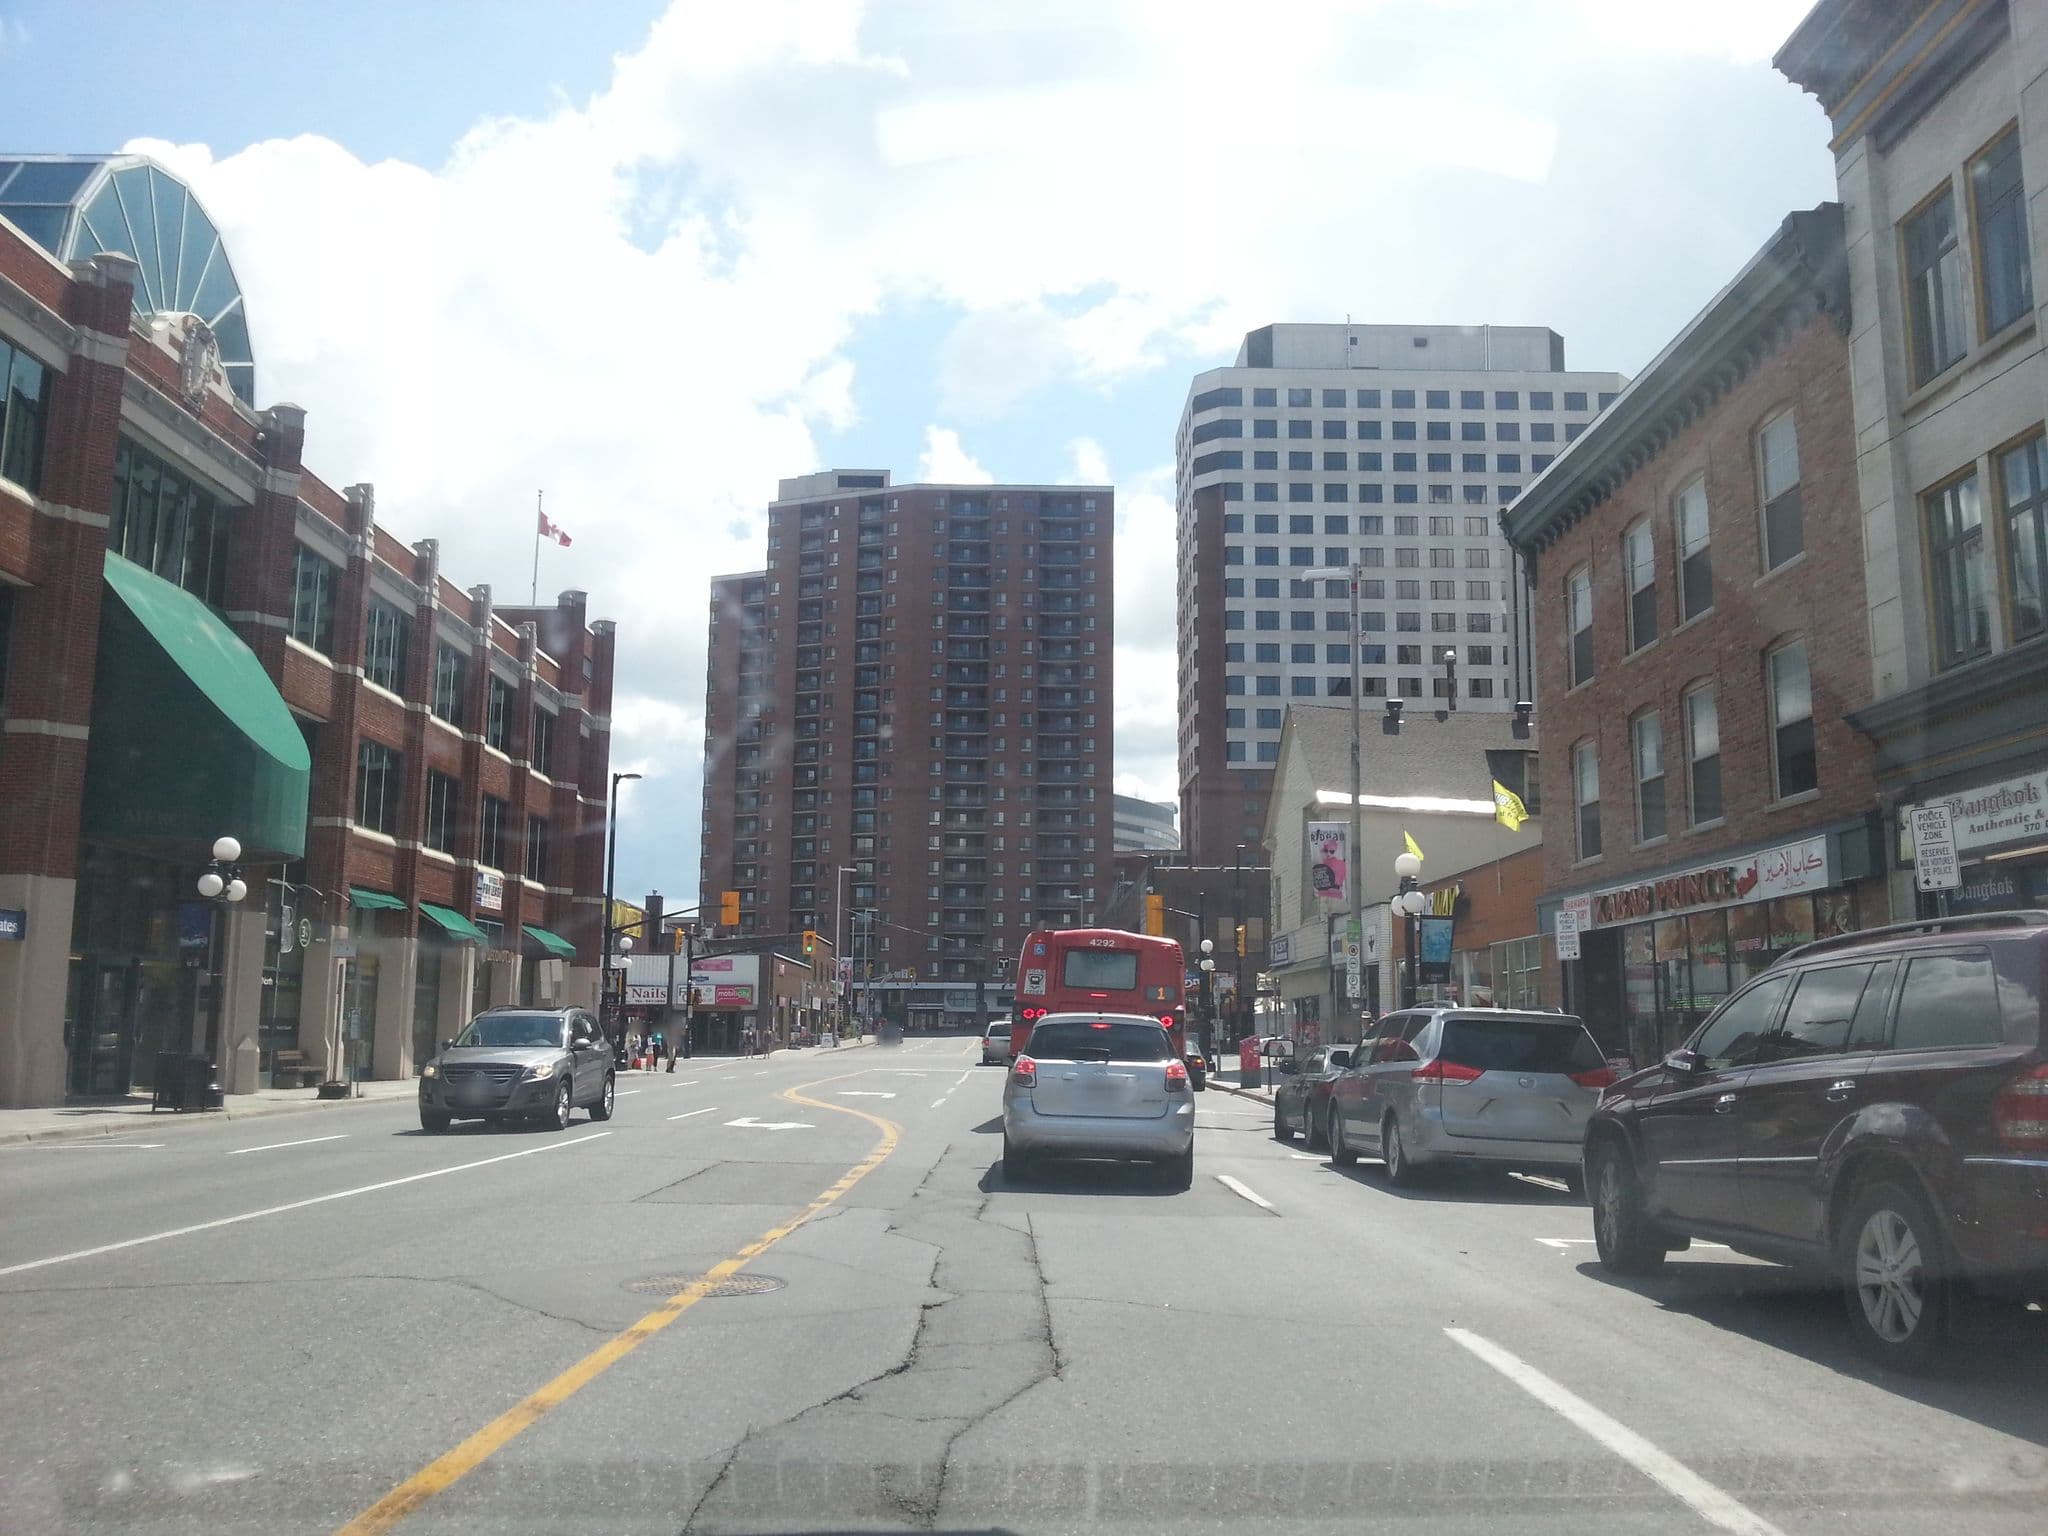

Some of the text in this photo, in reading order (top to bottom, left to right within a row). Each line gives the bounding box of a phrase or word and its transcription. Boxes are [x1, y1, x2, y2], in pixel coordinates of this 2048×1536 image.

[1917, 820, 1948, 832] VEHICLE
[1968, 812, 2030, 834] Authentic
[2034, 808, 2045, 820] &
[2024, 822, 2040, 833] 370
[1923, 830, 1943, 841] ZONE
[1655, 866, 1736, 911] PRINCE
[1089, 939, 1115, 947] 4292
[632, 988, 666, 999] Nails
[1156, 987, 1165, 1000] 1
